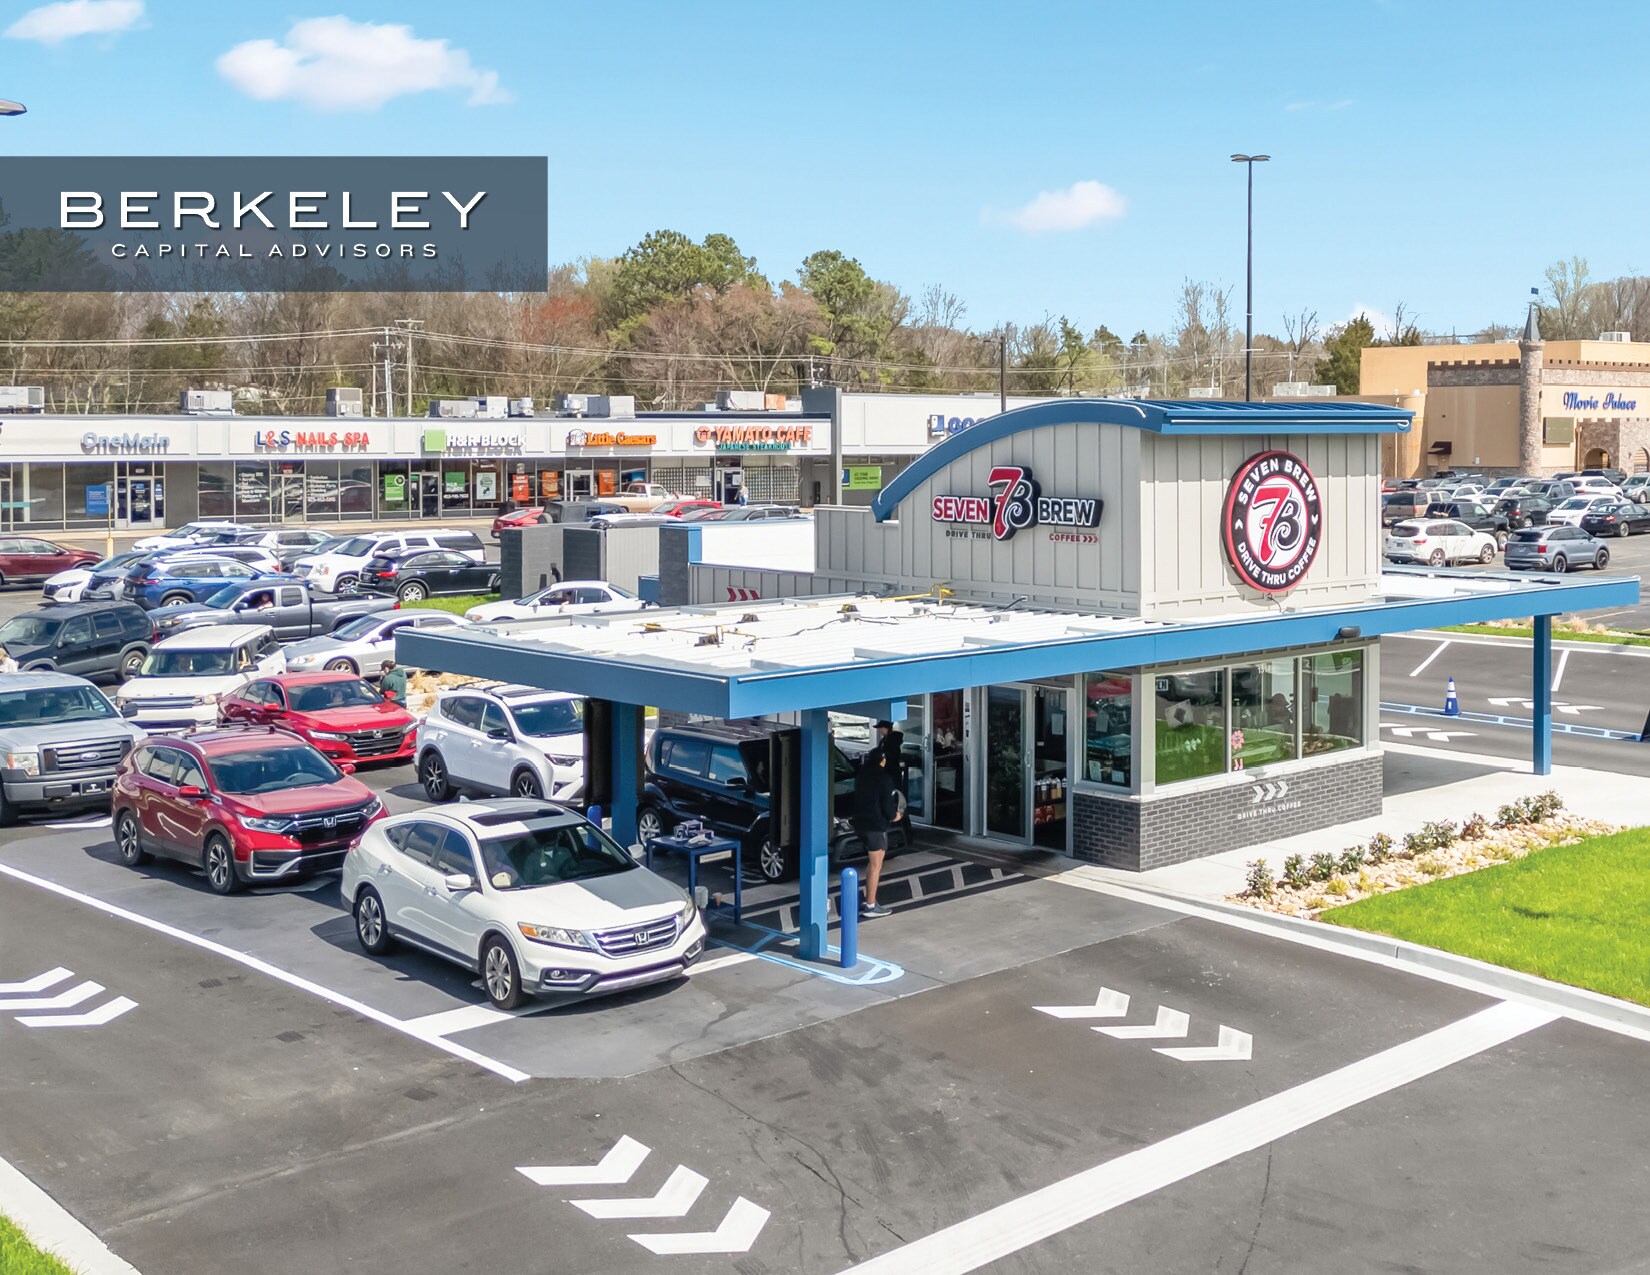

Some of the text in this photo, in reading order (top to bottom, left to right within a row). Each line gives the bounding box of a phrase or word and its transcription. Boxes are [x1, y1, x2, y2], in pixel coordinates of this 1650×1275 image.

[1563, 391, 1637, 410] Movie Palace
[82, 432, 169, 448] OneMain
[257, 430, 370, 447] L&S NAILS SPA
[446, 434, 528, 447] H&R BLOCK
[586, 432, 657, 446] Little Caesars
[713, 425, 813, 443] YAMATO CAFE
[1238, 458, 1317, 505] SEVEN BREW
[932, 497, 990, 522] SEVEN
[1037, 498, 1096, 526] BREW
[945, 529, 992, 540] DRIVE THRU
[1049, 533, 1081, 542] COFFEE
[1238, 537, 1317, 585] DRIVE THRU COFFEE
[1238, 801, 1301, 819] DRIVE THRU COFFEE
